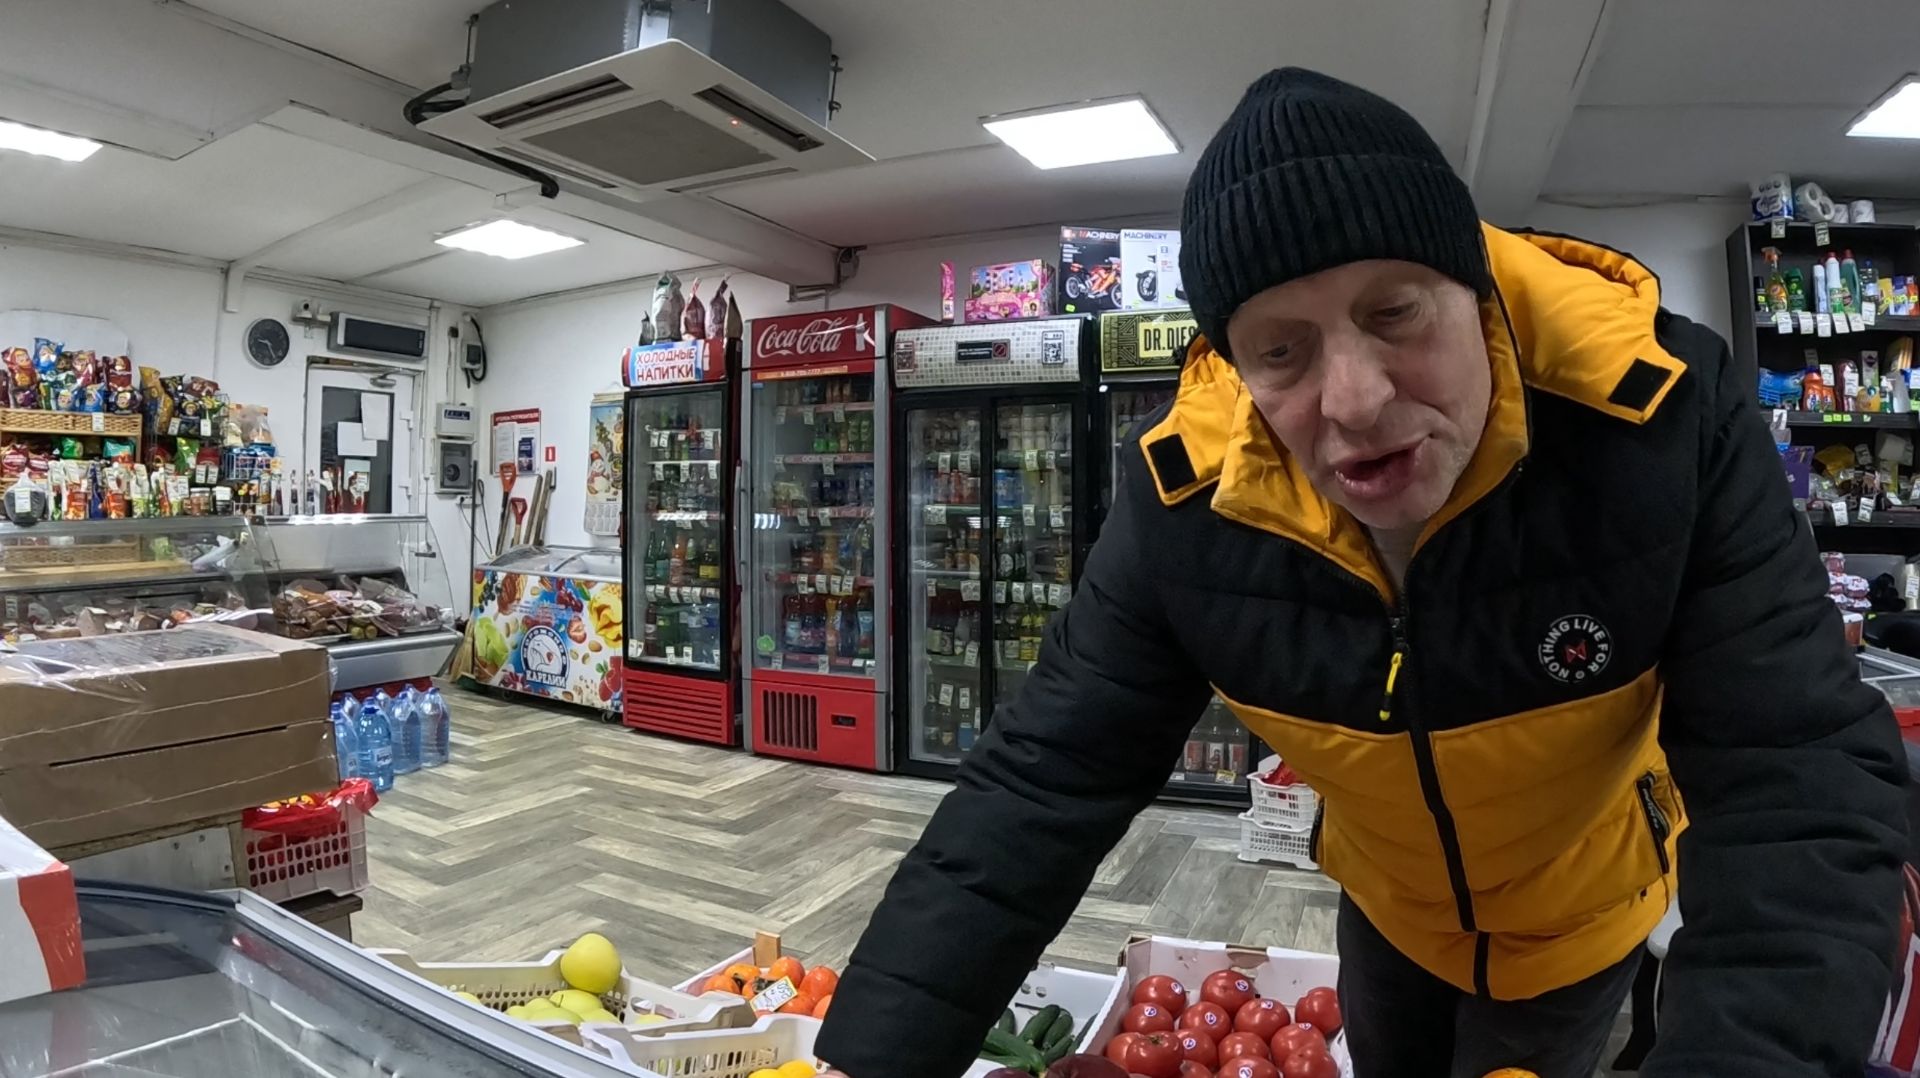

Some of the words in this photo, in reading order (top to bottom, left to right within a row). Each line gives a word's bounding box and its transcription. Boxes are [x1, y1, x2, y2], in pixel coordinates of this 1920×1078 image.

[1124, 232, 1167, 240] MACHINERY
[637, 348, 695, 364] ХОЛОДНЫЕ
[637, 364, 694, 381] НАПИТКИ
[1574, 618, 1606, 642] LIVE
[1542, 621, 1571, 679] NOTHING
[1587, 643, 1609, 673] FOR
